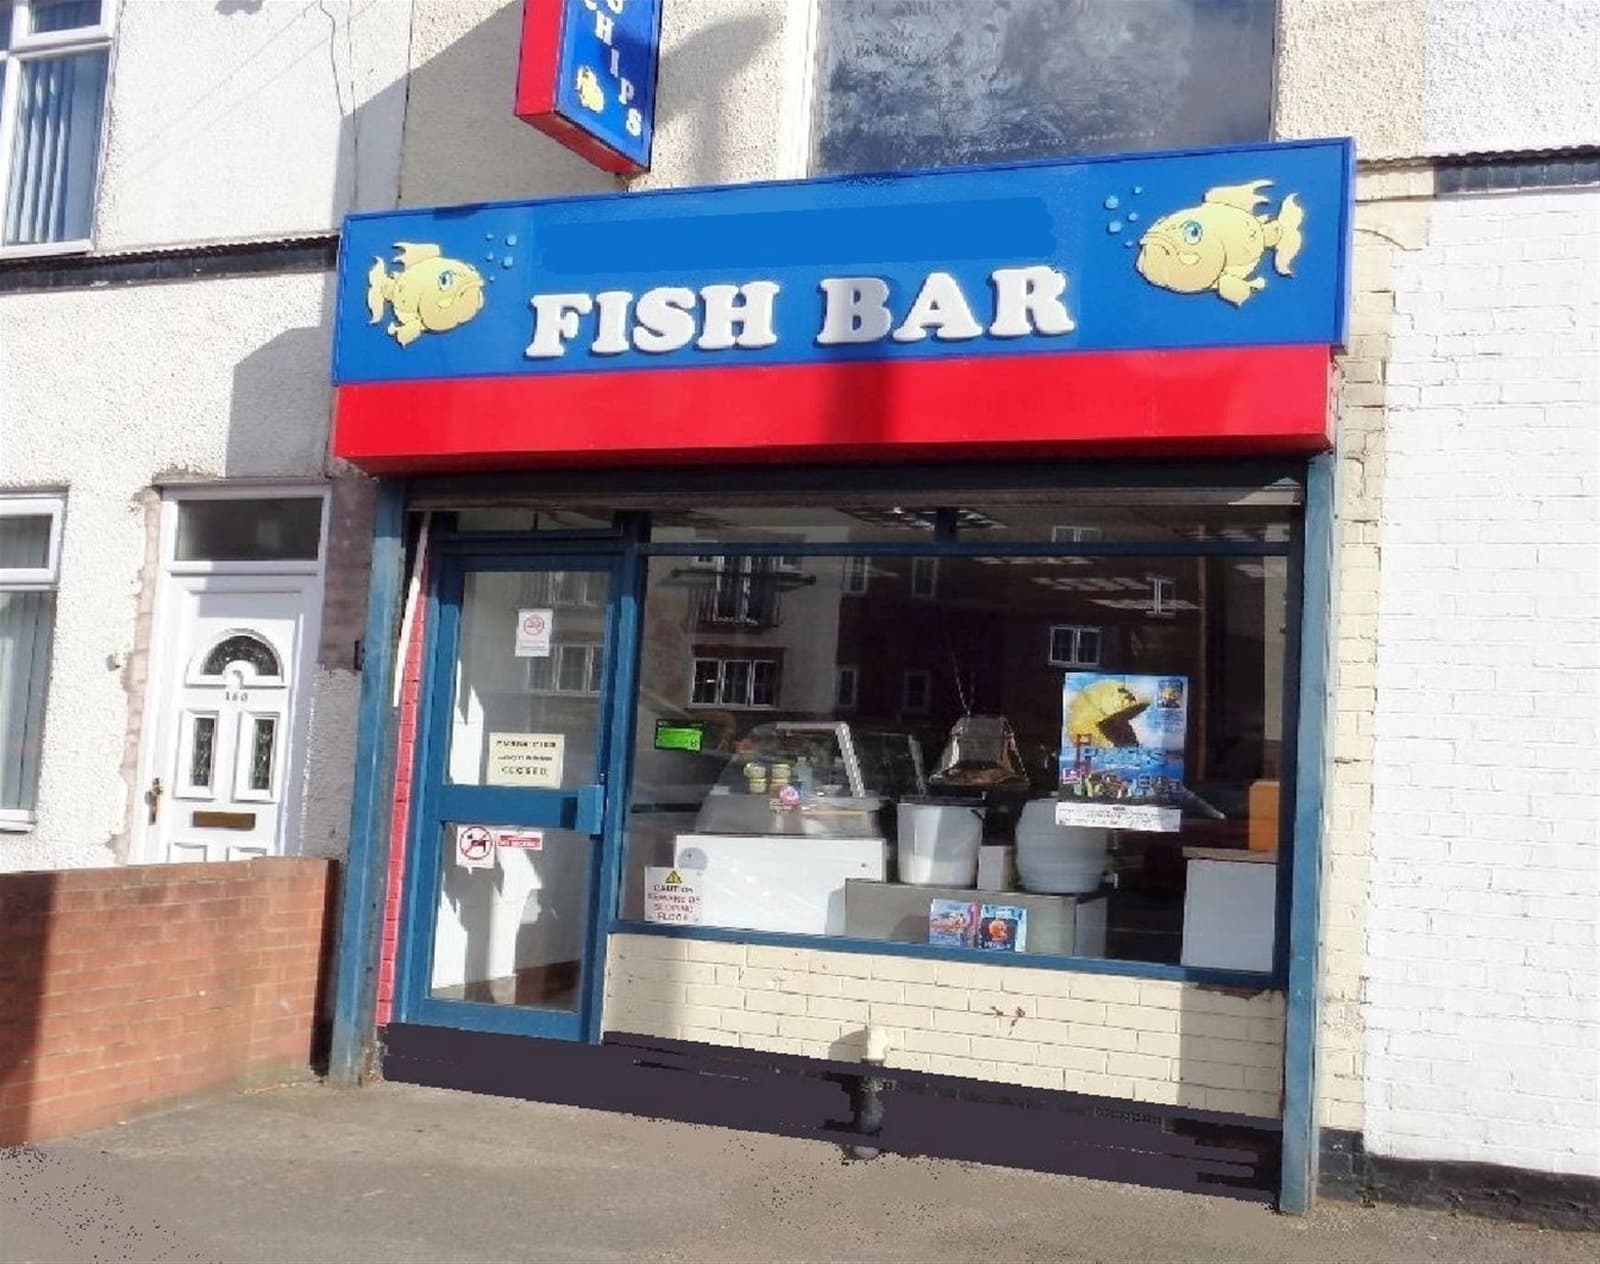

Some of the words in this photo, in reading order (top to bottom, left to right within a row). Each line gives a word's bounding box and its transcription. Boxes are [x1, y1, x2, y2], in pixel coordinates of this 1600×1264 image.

[525, 280, 780, 359] FISH
[816, 265, 1076, 346] BAR
[653, 884, 694, 893] CAUTON
